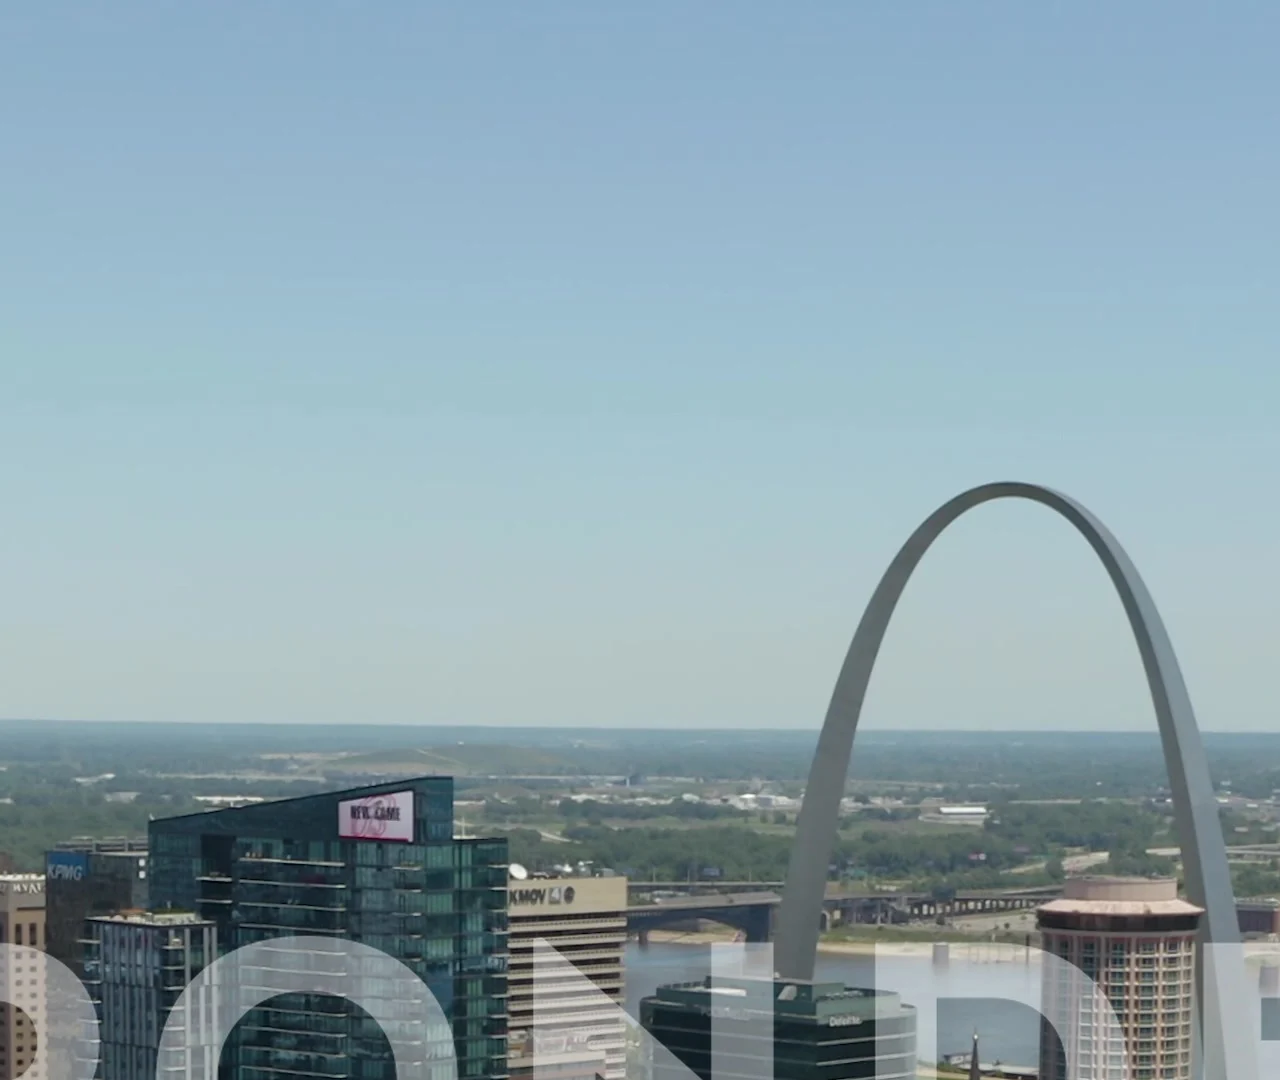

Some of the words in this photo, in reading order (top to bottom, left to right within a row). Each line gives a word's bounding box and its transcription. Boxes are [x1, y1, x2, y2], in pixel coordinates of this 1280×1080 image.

[48, 863, 82, 880] KPMG
[510, 888, 546, 905] KMOV
[829, 1015, 863, 1027] Deloitte
